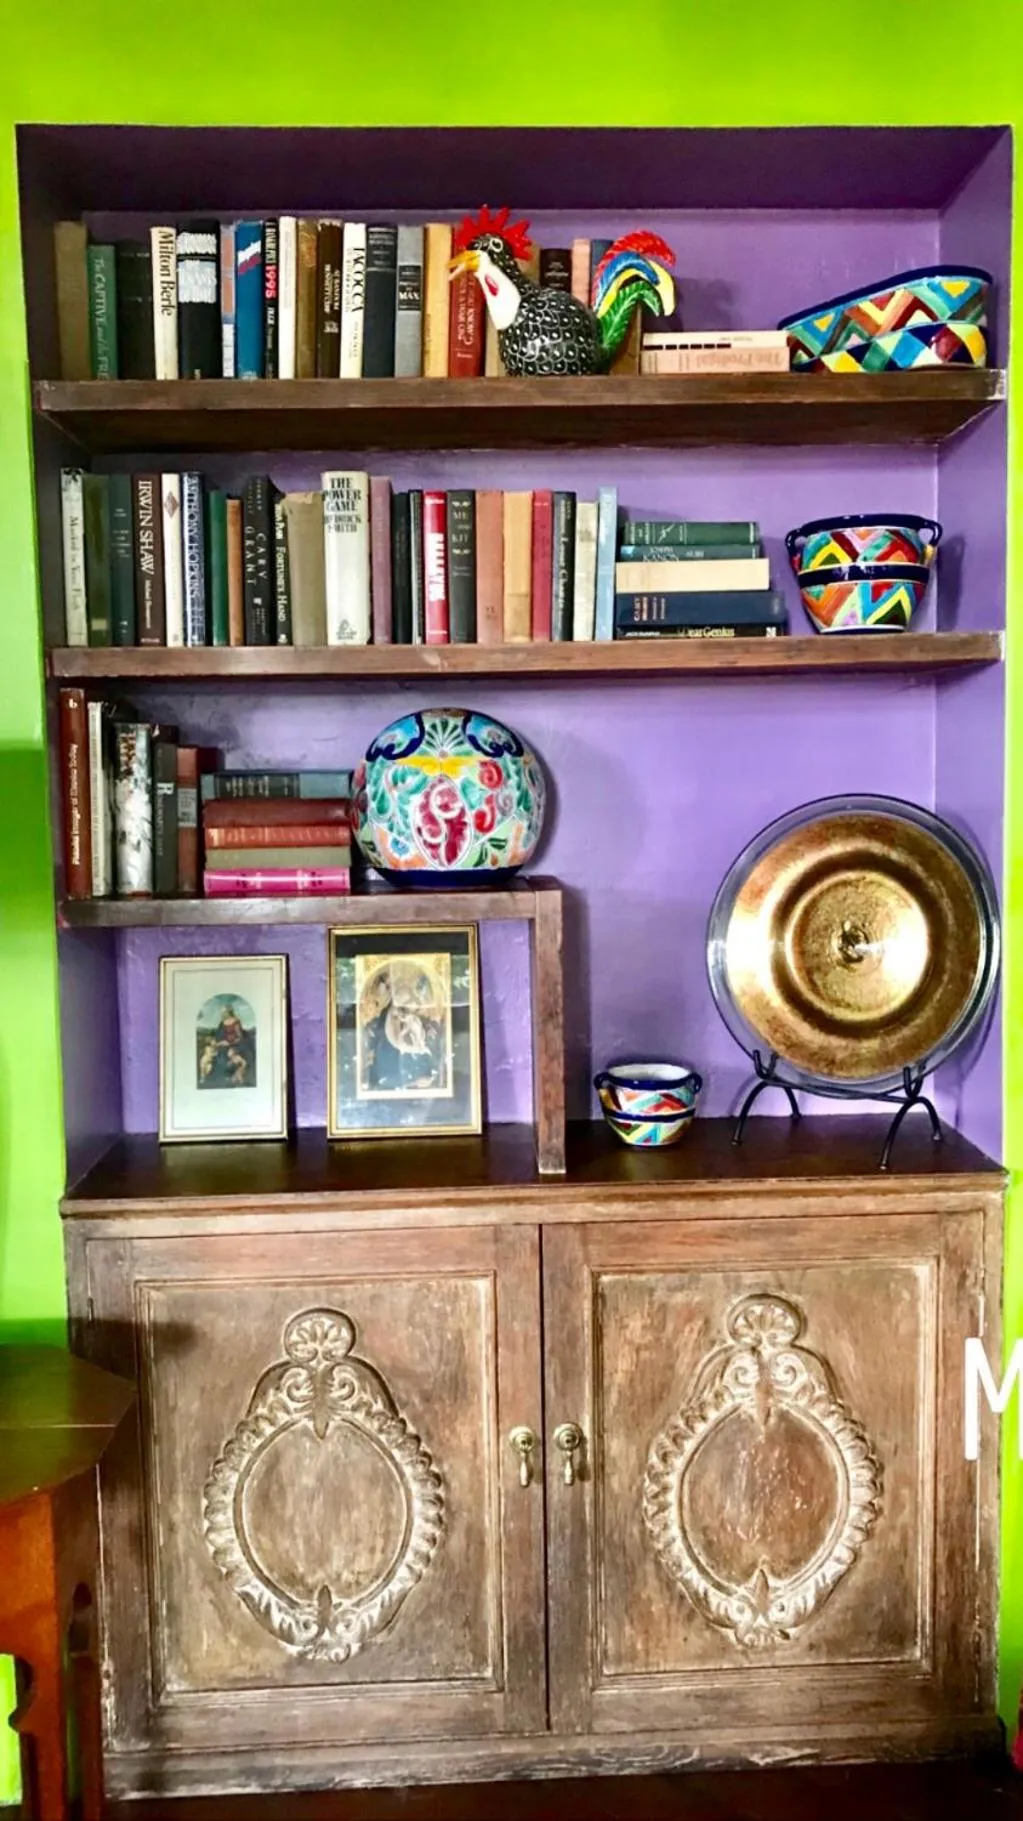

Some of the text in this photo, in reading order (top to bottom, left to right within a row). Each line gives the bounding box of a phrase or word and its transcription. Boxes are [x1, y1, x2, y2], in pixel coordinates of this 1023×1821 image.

[158, 230, 176, 317] Milton Berle
[265, 265, 277, 298] 1995
[351, 248, 365, 312] IACOCCA
[399, 291, 420, 300] MAX
[94, 273, 107, 326] CAPTIVE
[696, 352, 781, 369] The Prodigal
[321, 489, 362, 501] POWER
[326, 500, 358, 511] GAME
[330, 477, 353, 489] THE
[139, 480, 155, 576] IRWIN SHAW
[186, 475, 199, 540] ANTHONY
[188, 543, 201, 599] HOPKINS
[244, 526, 257, 585] GRANT
[256, 533, 268, 580] CARY
[277, 595, 288, 622] HAND
